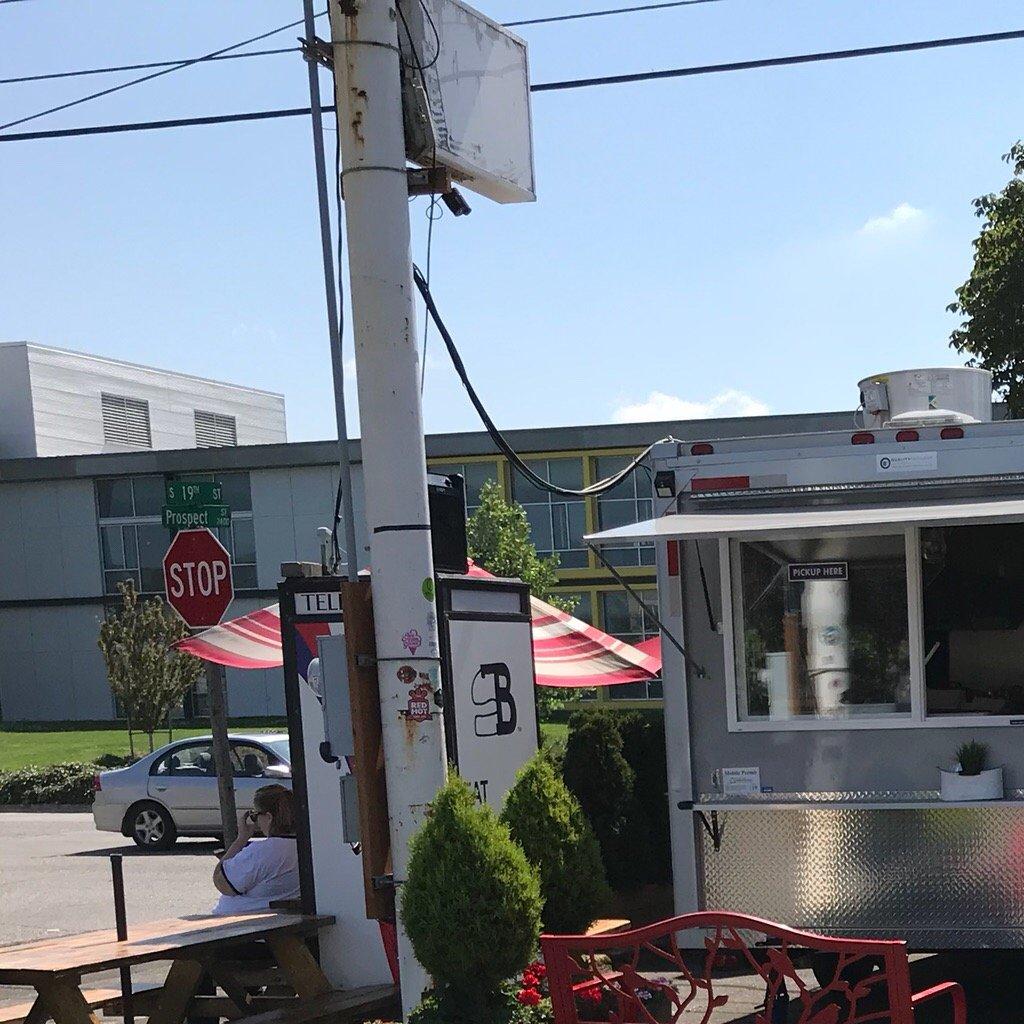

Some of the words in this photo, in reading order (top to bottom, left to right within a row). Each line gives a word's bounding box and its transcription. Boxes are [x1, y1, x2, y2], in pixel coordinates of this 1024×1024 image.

[169, 486, 175, 499] S
[182, 485, 200, 500] 19TH
[212, 488, 221, 500] ST
[165, 509, 208, 527] Prospect
[169, 560, 227, 598] STOP
[792, 568, 821, 577] PICKUP
[823, 566, 843, 576] HERE
[410, 701, 428, 709] RED
